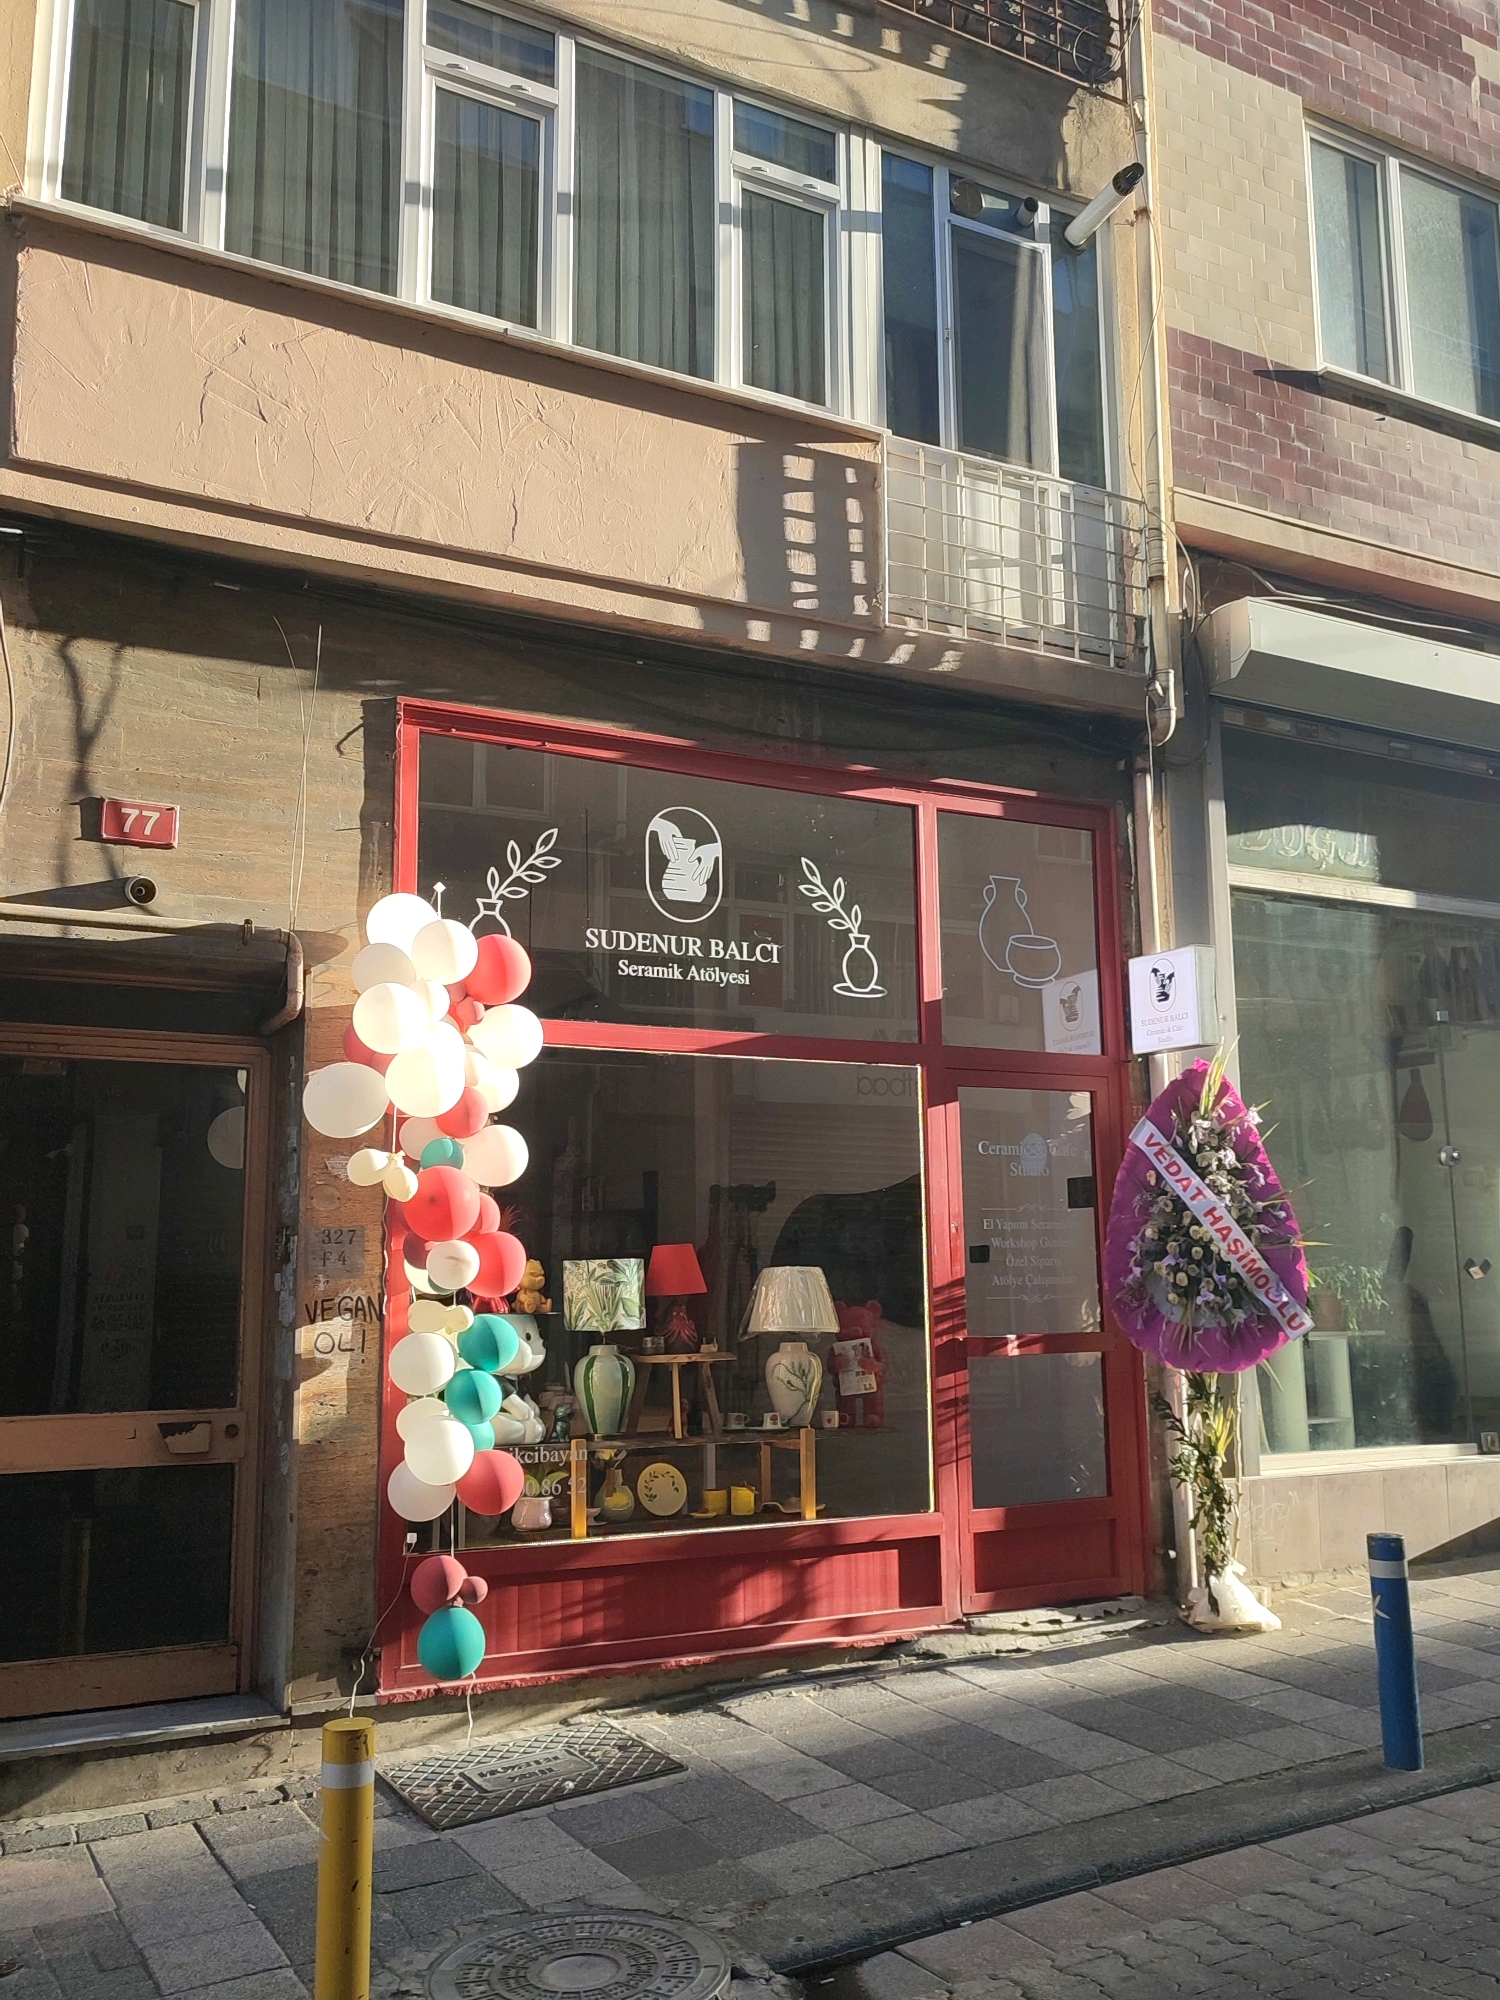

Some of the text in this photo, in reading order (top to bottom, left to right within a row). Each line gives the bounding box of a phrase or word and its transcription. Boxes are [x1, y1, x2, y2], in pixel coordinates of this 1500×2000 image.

[121, 807, 160, 836] 77
[585, 927, 780, 964] SUDENUR BALCI
[618, 959, 750, 987] Seramik Atölyesi
[1140, 1012, 1189, 1027] SUDENUR BALCI
[978, 1140, 1030, 1156] Ceramic
[1009, 1161, 1050, 1176] Studio
[1143, 1131, 1208, 1203] VEDAT
[983, 1218, 994, 1230] El
[321, 1228, 357, 1245] 327
[990, 1237, 1038, 1251] Workshop
[1006, 1253, 1028, 1267] Özel
[991, 1274, 1023, 1288] Atölye
[304, 1293, 382, 1324] VEGAN
[509, 1446, 588, 1467] ikcibayan
[541, 1478, 562, 1496] 86
